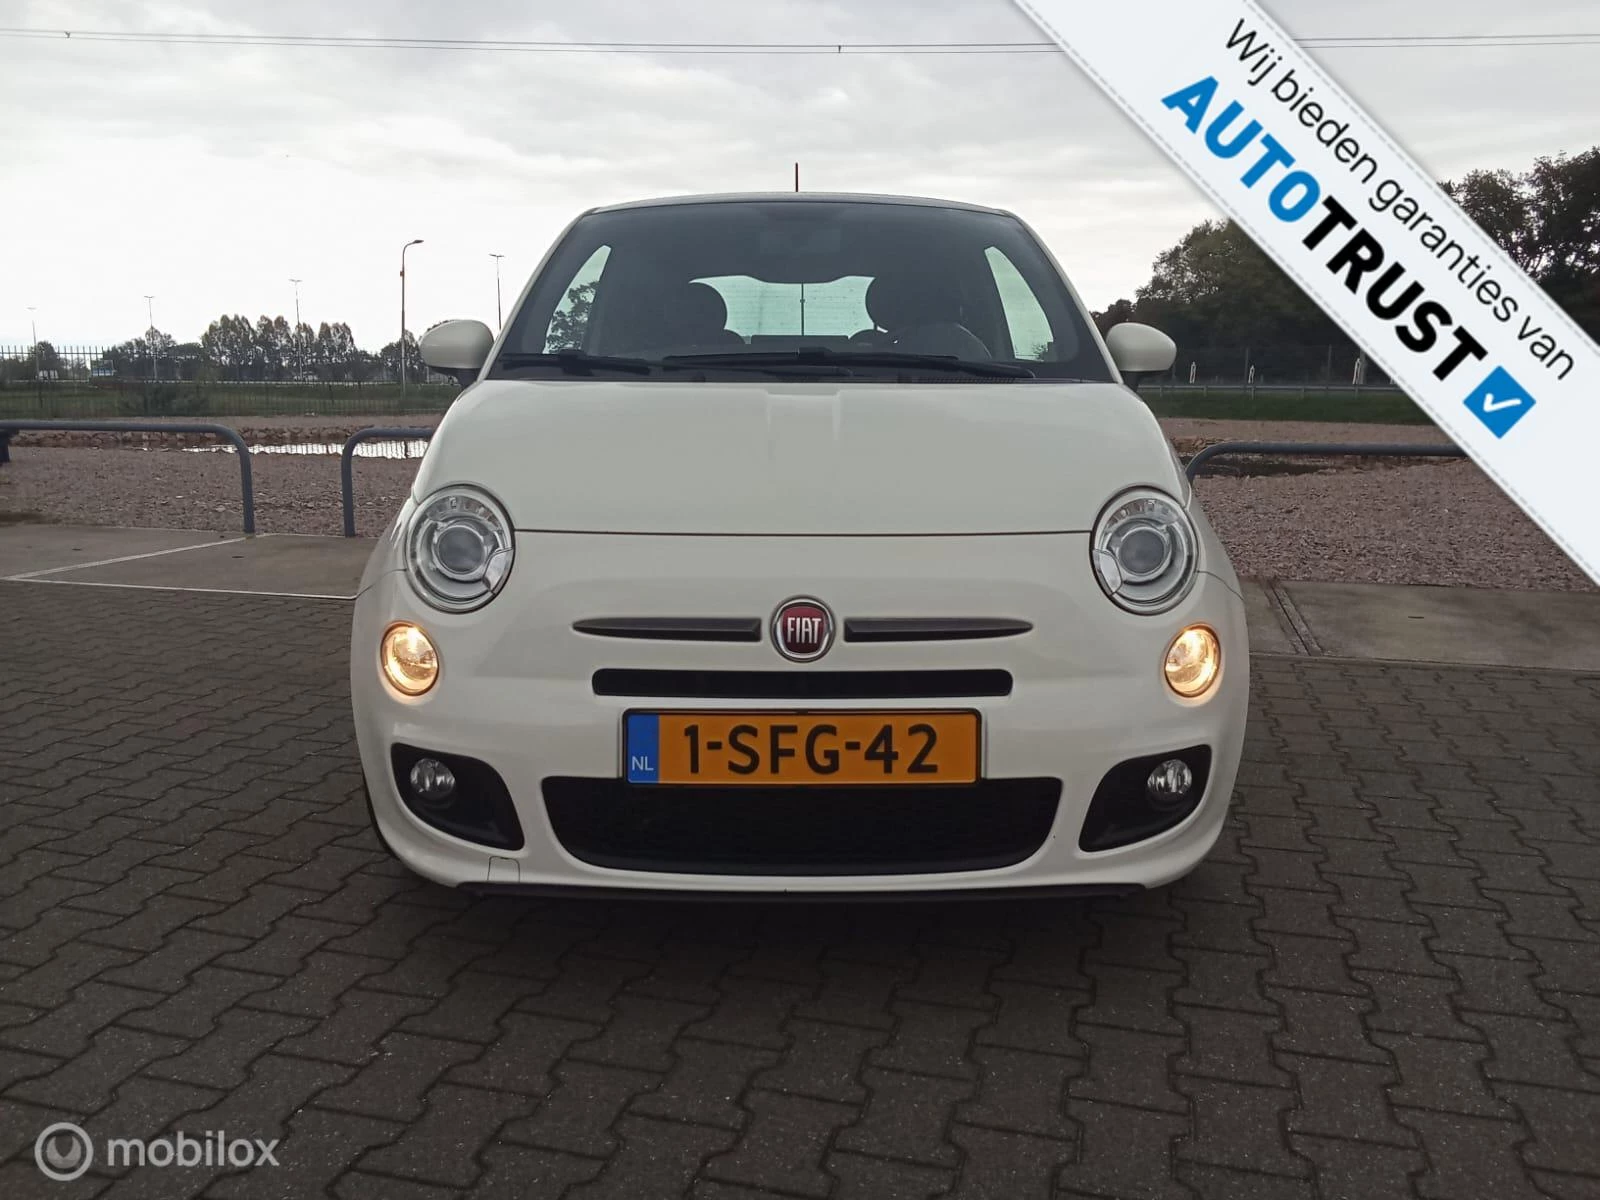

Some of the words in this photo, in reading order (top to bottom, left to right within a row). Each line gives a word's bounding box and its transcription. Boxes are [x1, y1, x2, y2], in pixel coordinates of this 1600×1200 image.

[786, 616, 822, 644] FIAT
[631, 755, 654, 771] NL
[683, 723, 939, 775] 1-SFG-42
